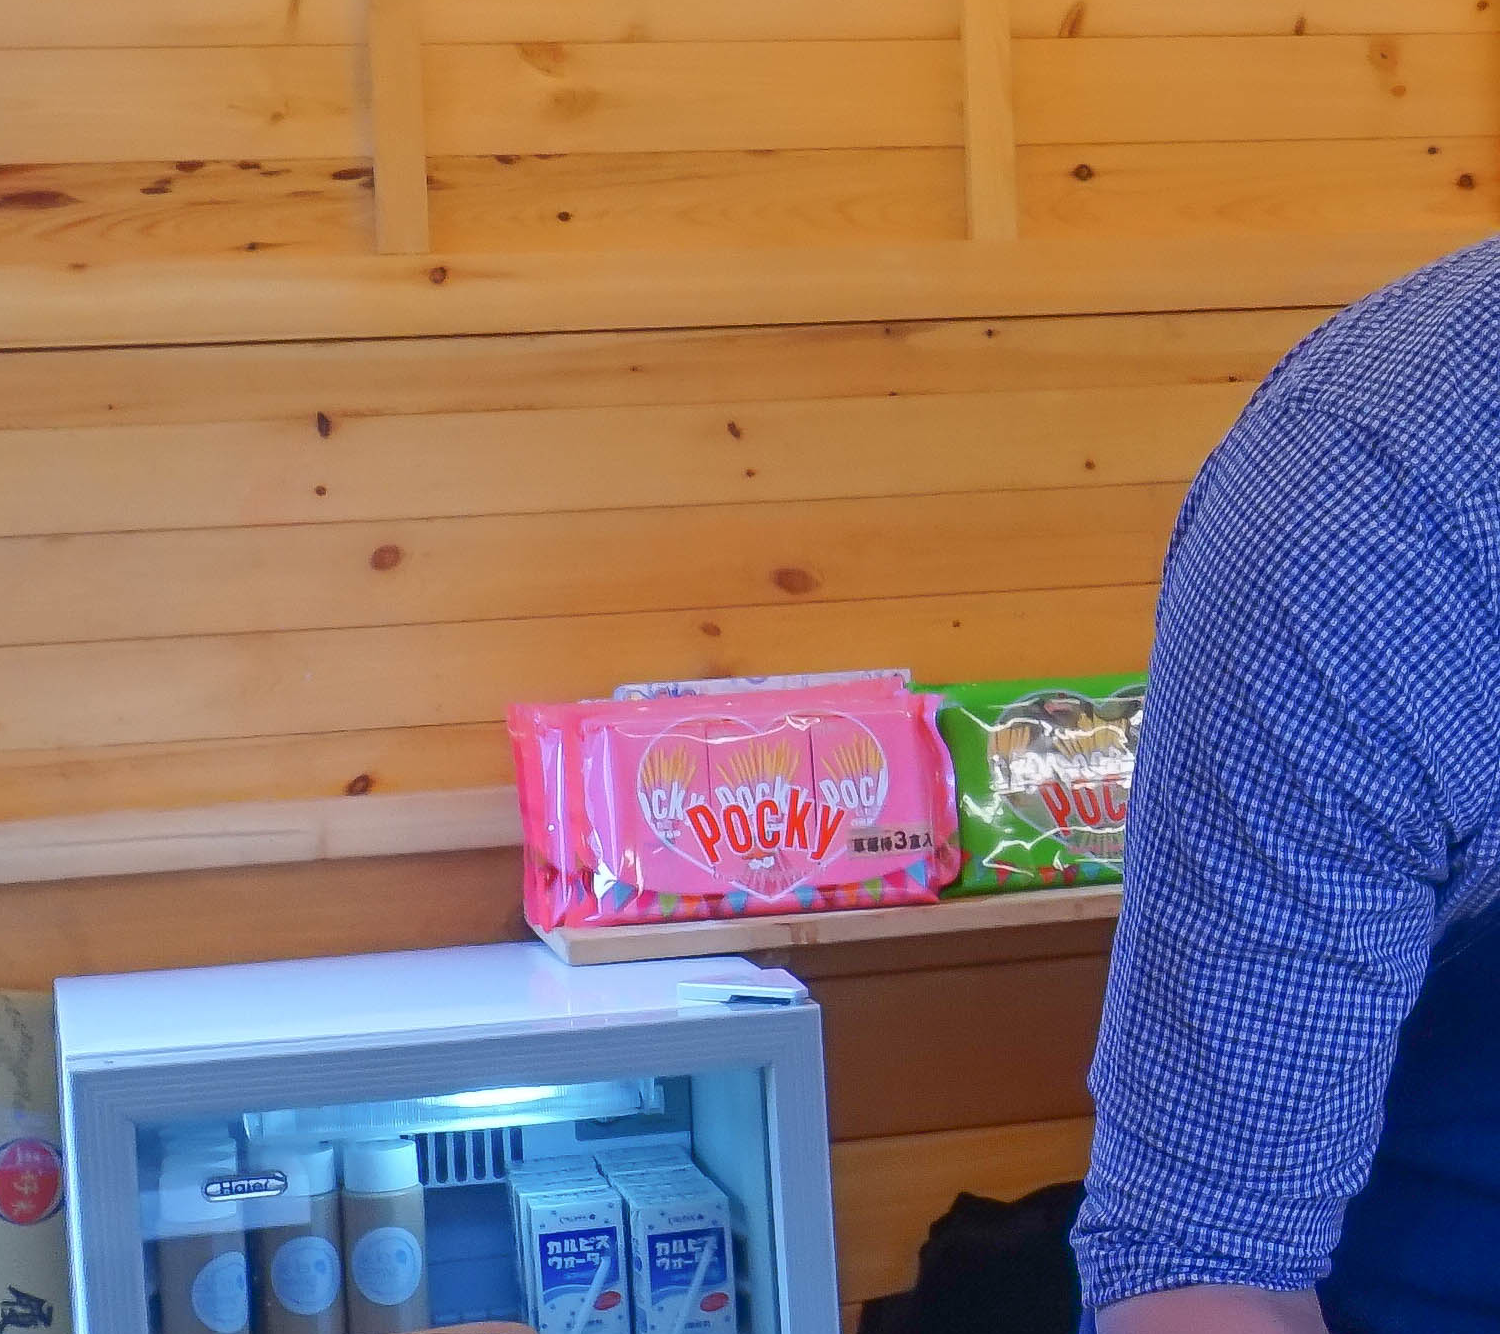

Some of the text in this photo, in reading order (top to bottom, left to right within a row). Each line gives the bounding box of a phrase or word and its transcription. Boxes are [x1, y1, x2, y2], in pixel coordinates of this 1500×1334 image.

[220, 1178, 272, 1197] Haier
[546, 1234, 610, 1255] カルピス
[547, 1252, 601, 1271] ウォータ
